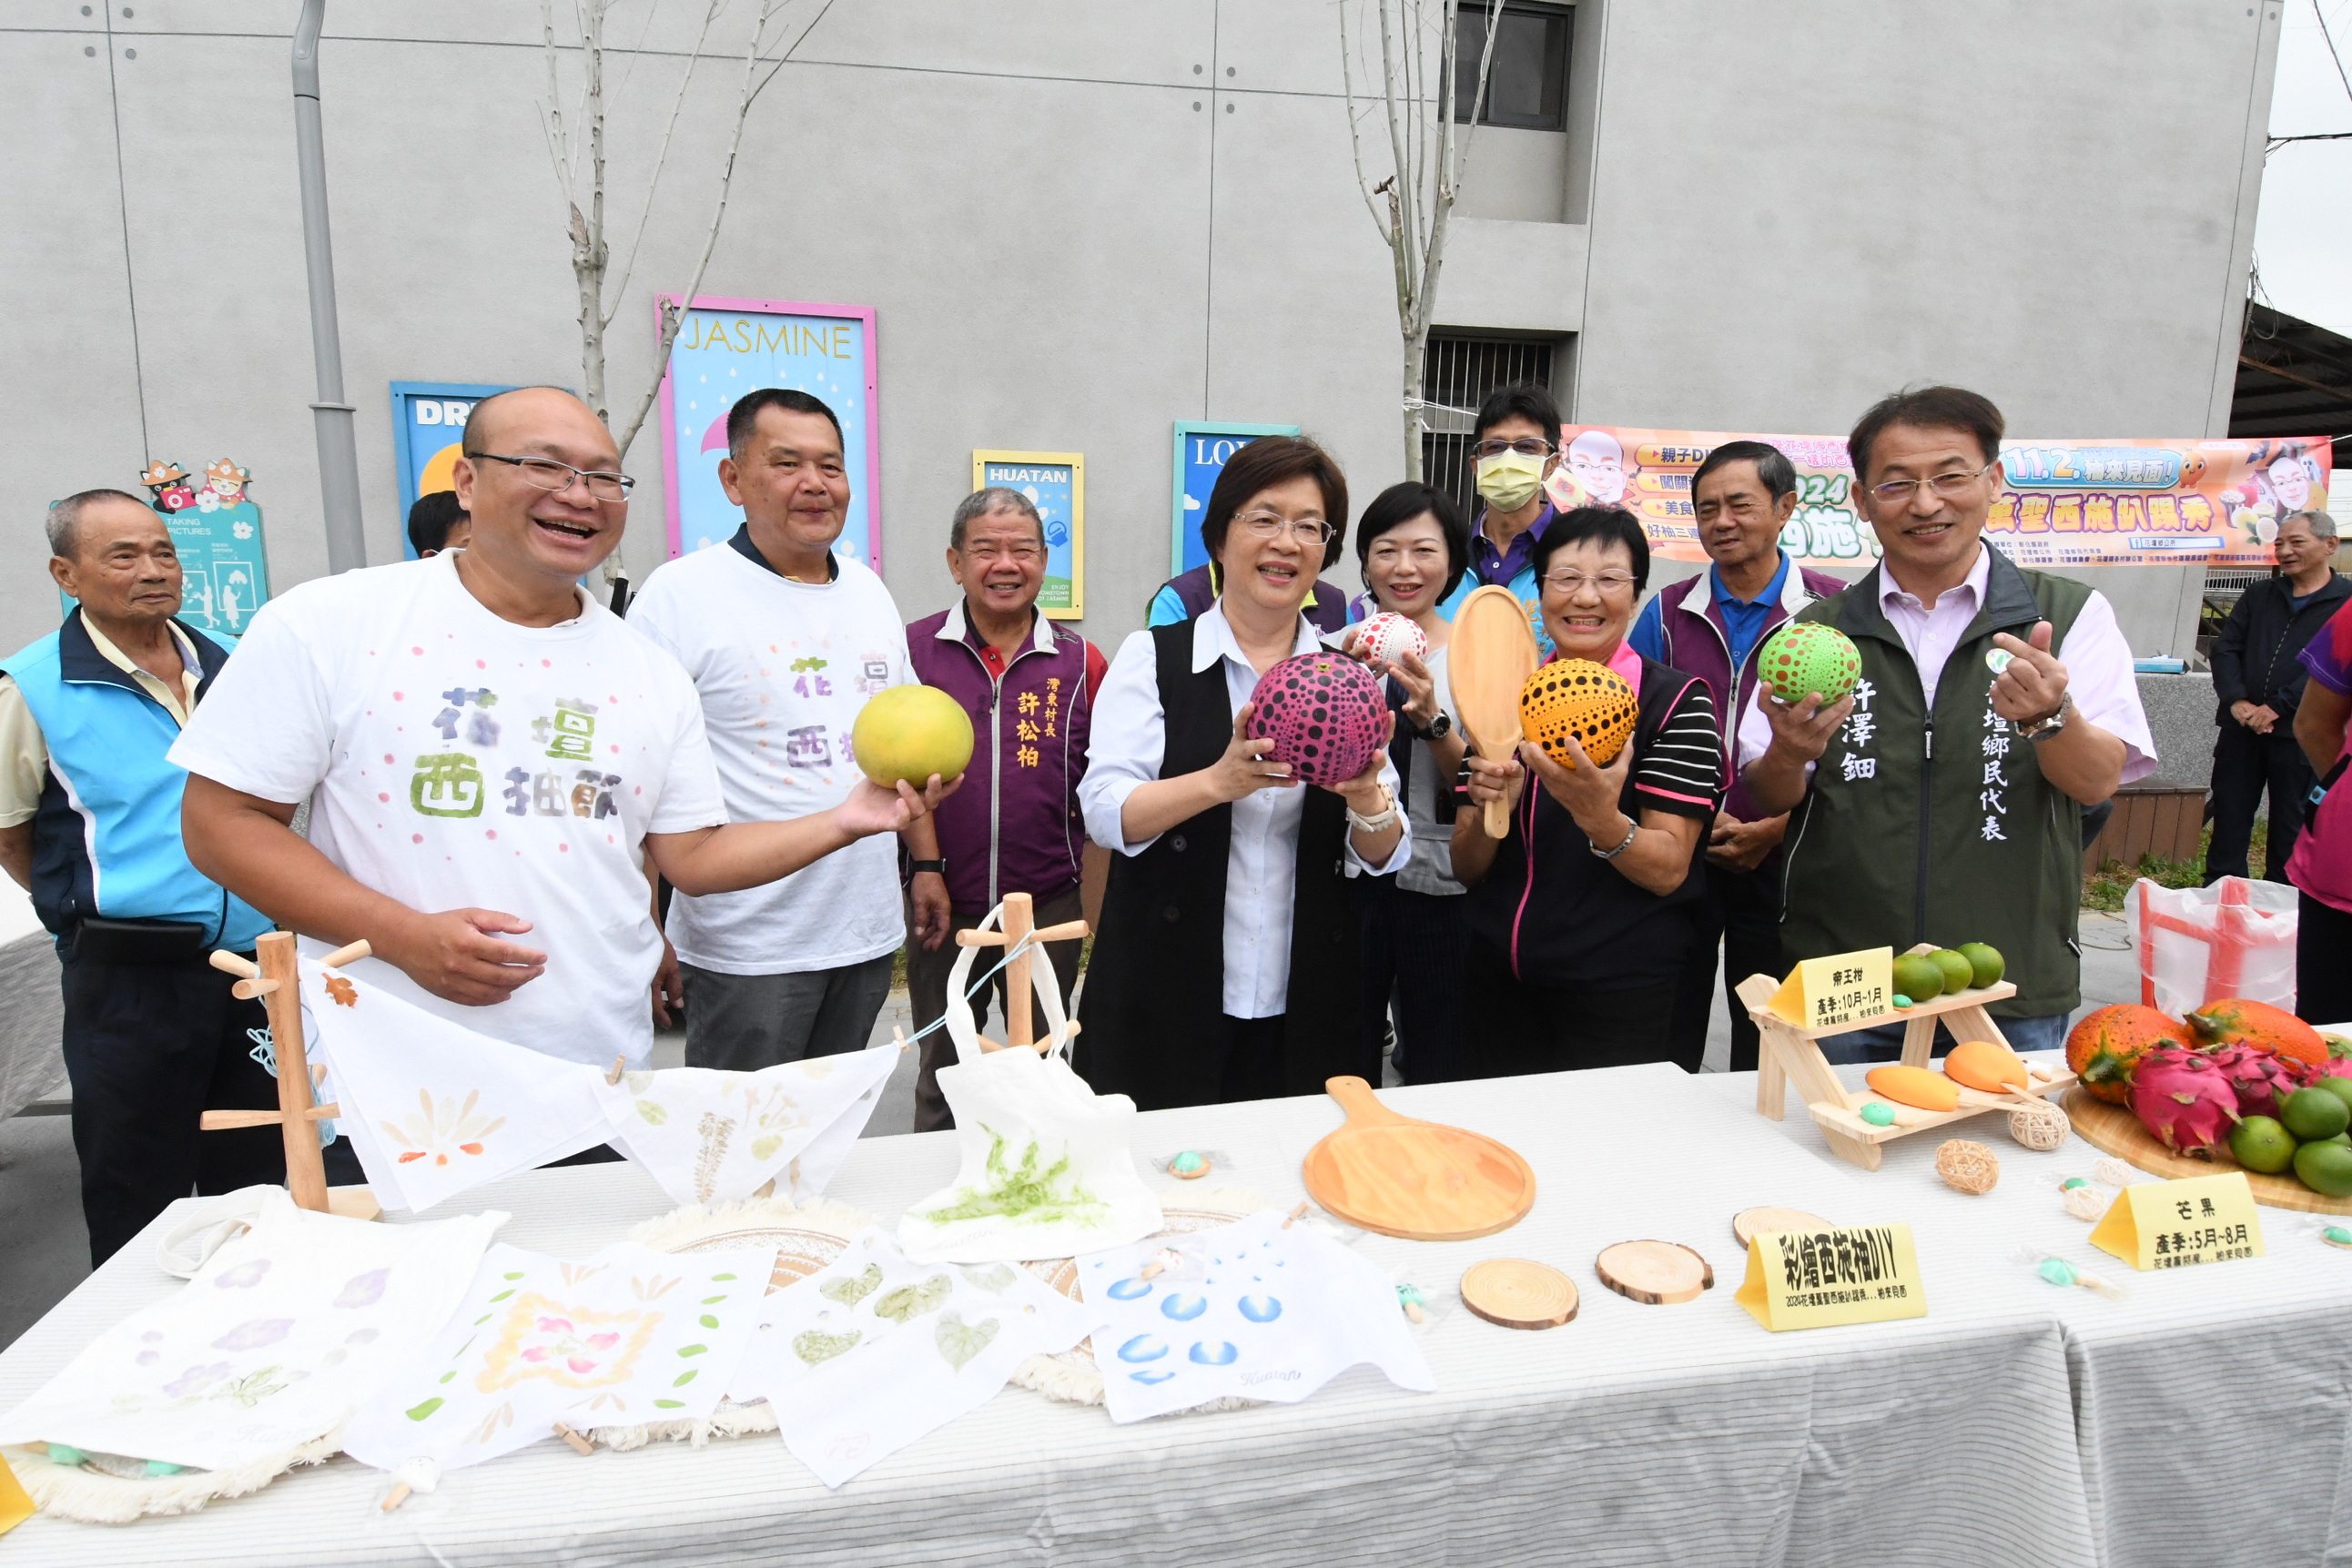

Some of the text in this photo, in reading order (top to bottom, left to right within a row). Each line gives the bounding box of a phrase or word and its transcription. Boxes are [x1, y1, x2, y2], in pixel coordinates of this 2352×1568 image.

[684, 317, 852, 359] JASMINE
[416, 400, 477, 427] DR
[989, 468, 1067, 484] HUATAN
[167, 518, 200, 526] TAKING
[167, 528, 212, 536] PICTURES
[431, 687, 599, 762] 花壇
[1044, 677, 1060, 738] 灣東村長
[1016, 692, 1040, 768] 許松柏
[1980, 681, 2011, 841] 壇鄉民代表
[1832, 967, 1863, 987] 帝王柑
